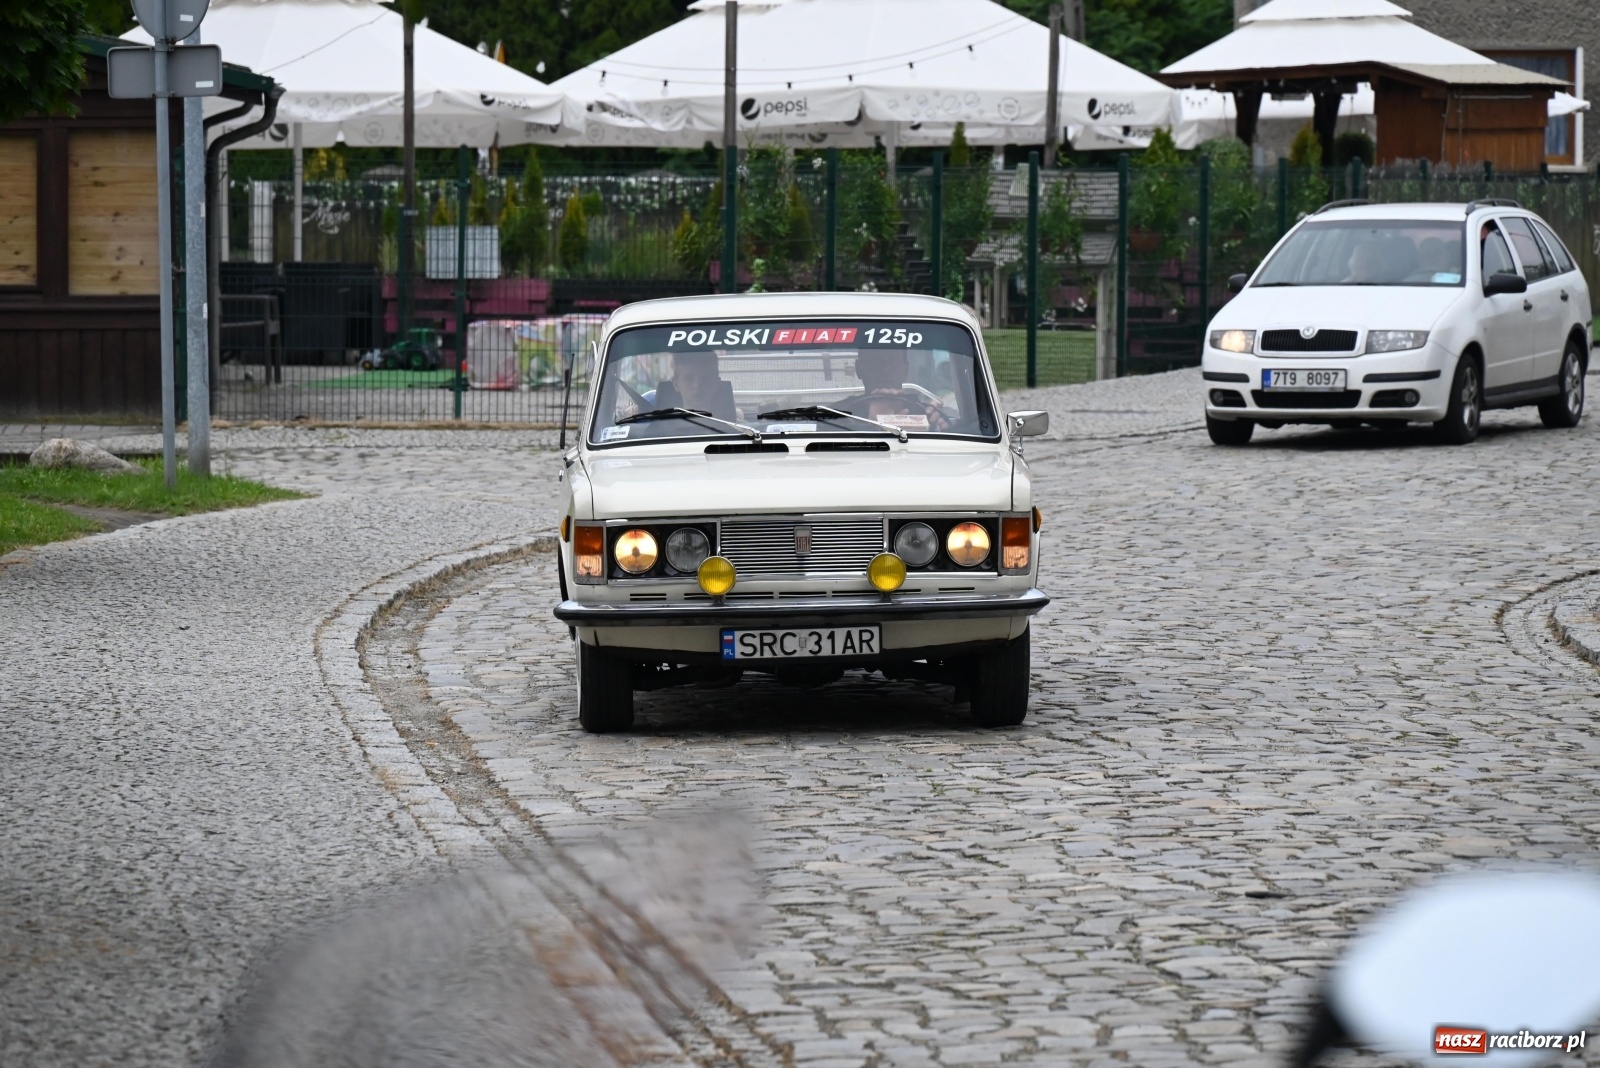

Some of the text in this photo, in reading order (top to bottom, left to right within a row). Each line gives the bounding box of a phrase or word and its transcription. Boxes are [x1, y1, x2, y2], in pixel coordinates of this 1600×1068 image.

[763, 97, 808, 116] pepsi
[1103, 102, 1136, 117] pepsi
[668, 328, 923, 347] POLSKI FIAT 125p
[1273, 371, 1340, 386] 7T9 8097
[739, 629, 876, 657] SRC 31AR
[724, 648, 734, 656] PL
